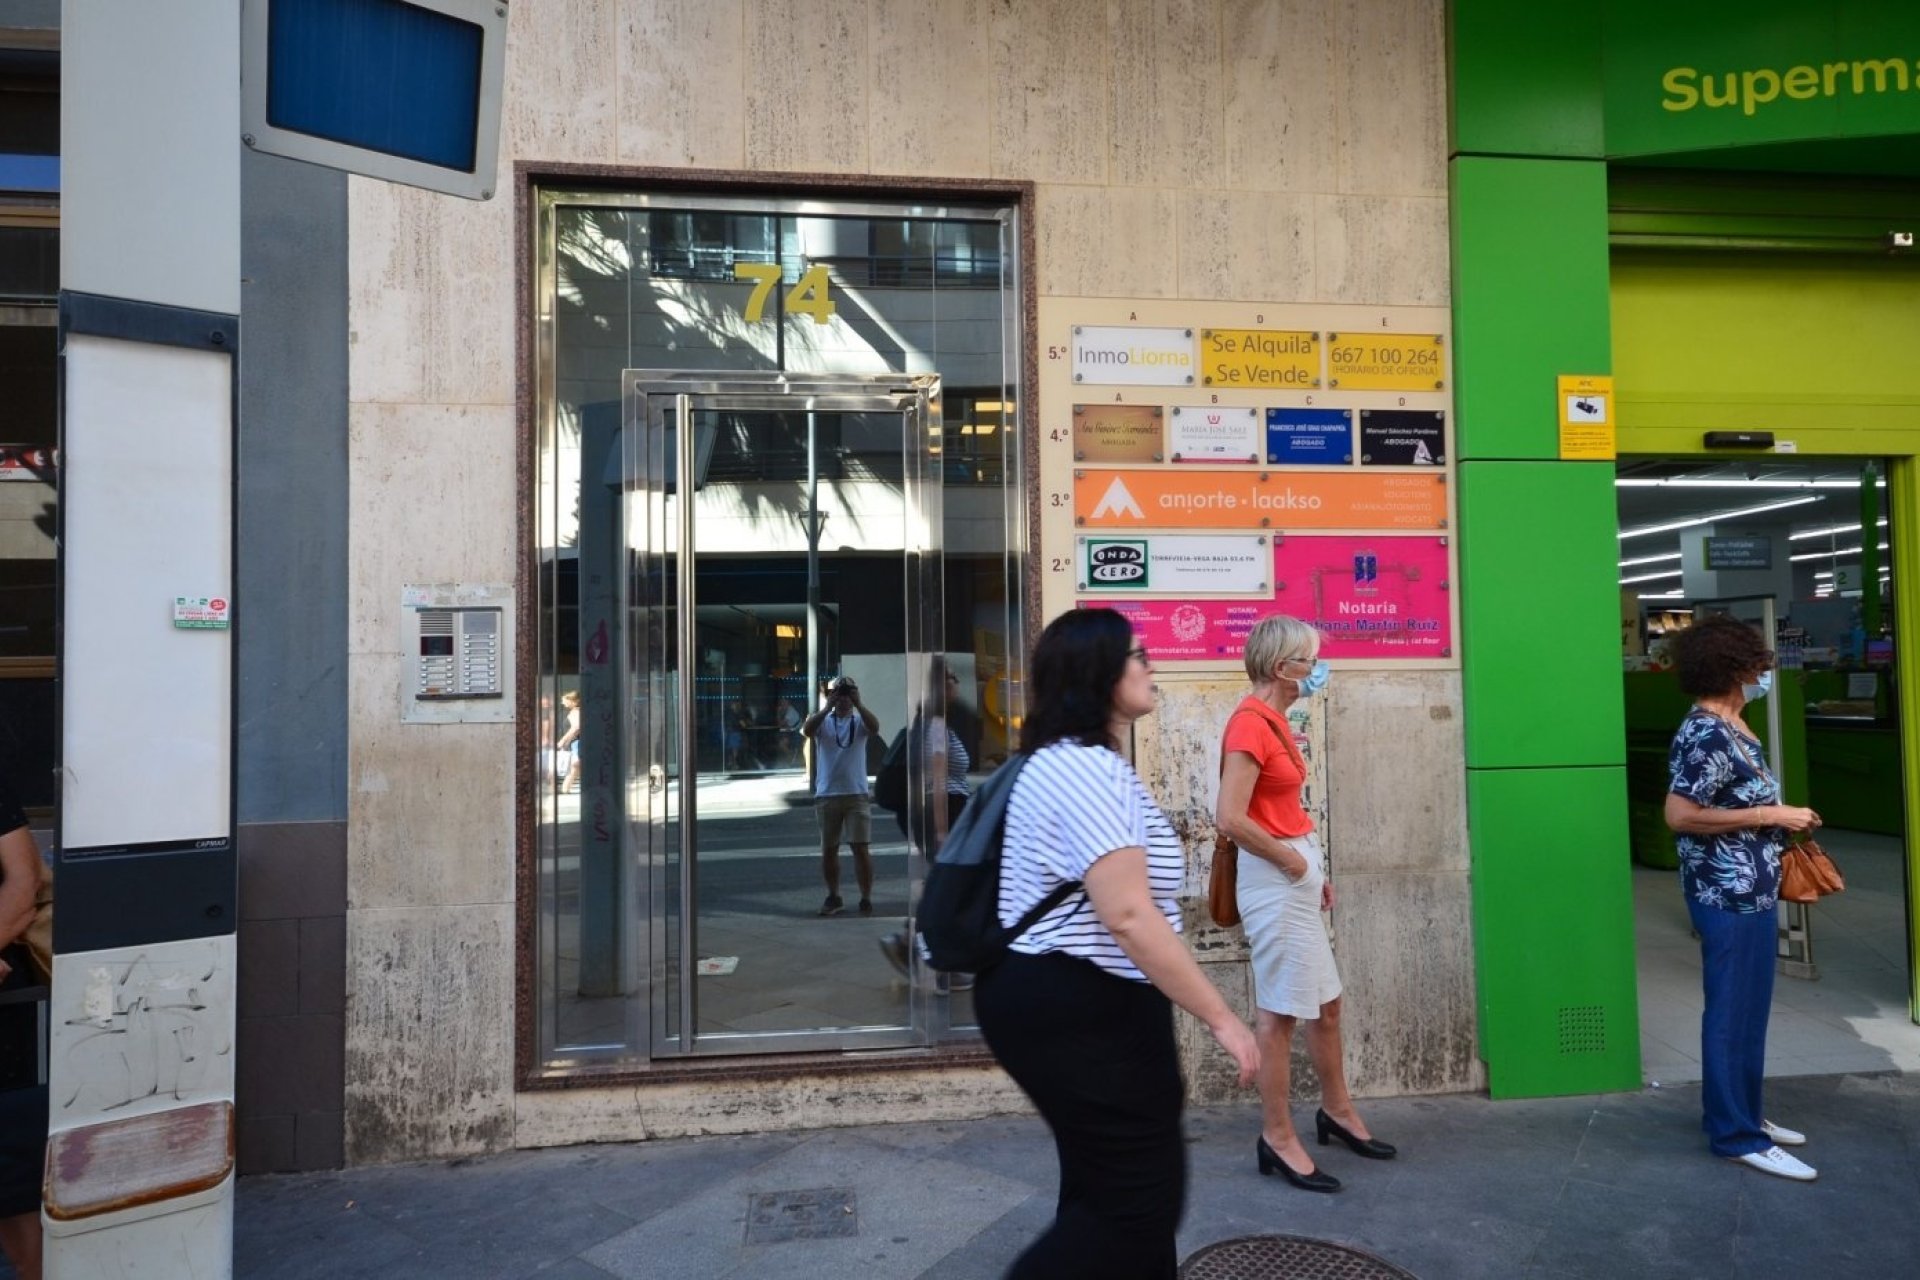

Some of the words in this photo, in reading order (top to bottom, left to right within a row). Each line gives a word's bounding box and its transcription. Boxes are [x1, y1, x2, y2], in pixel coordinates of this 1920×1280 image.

[1662, 58, 1920, 115] Superm
[735, 263, 836, 325] 74
[1130, 311, 1137, 321] A
[1256, 314, 1264, 324] D
[1382, 317, 1388, 327] E
[1212, 334, 1236, 352] Se
[1242, 335, 1311, 358] Alquila
[1079, 346, 1190, 366] InmoLiorna
[1331, 348, 1363, 363] 667
[1370, 348, 1402, 364] 100
[1407, 349, 1439, 365] 264
[1217, 364, 1240, 382] Se
[1245, 365, 1309, 383] Vende
[1382, 366, 1393, 375] DE
[1115, 393, 1122, 402] A
[1211, 394, 1218, 404] B
[1306, 395, 1312, 405] C
[1398, 397, 1406, 407] D
[1388, 427, 1412, 435] Sánchez
[1384, 438, 1420, 446] ABOGADO
[1252, 486, 1322, 510] laakso
[1097, 551, 1137, 559] ONDA
[1100, 566, 1137, 577] CERO
[1838, 571, 1848, 585] 2
[1338, 600, 1397, 614] Notaría
